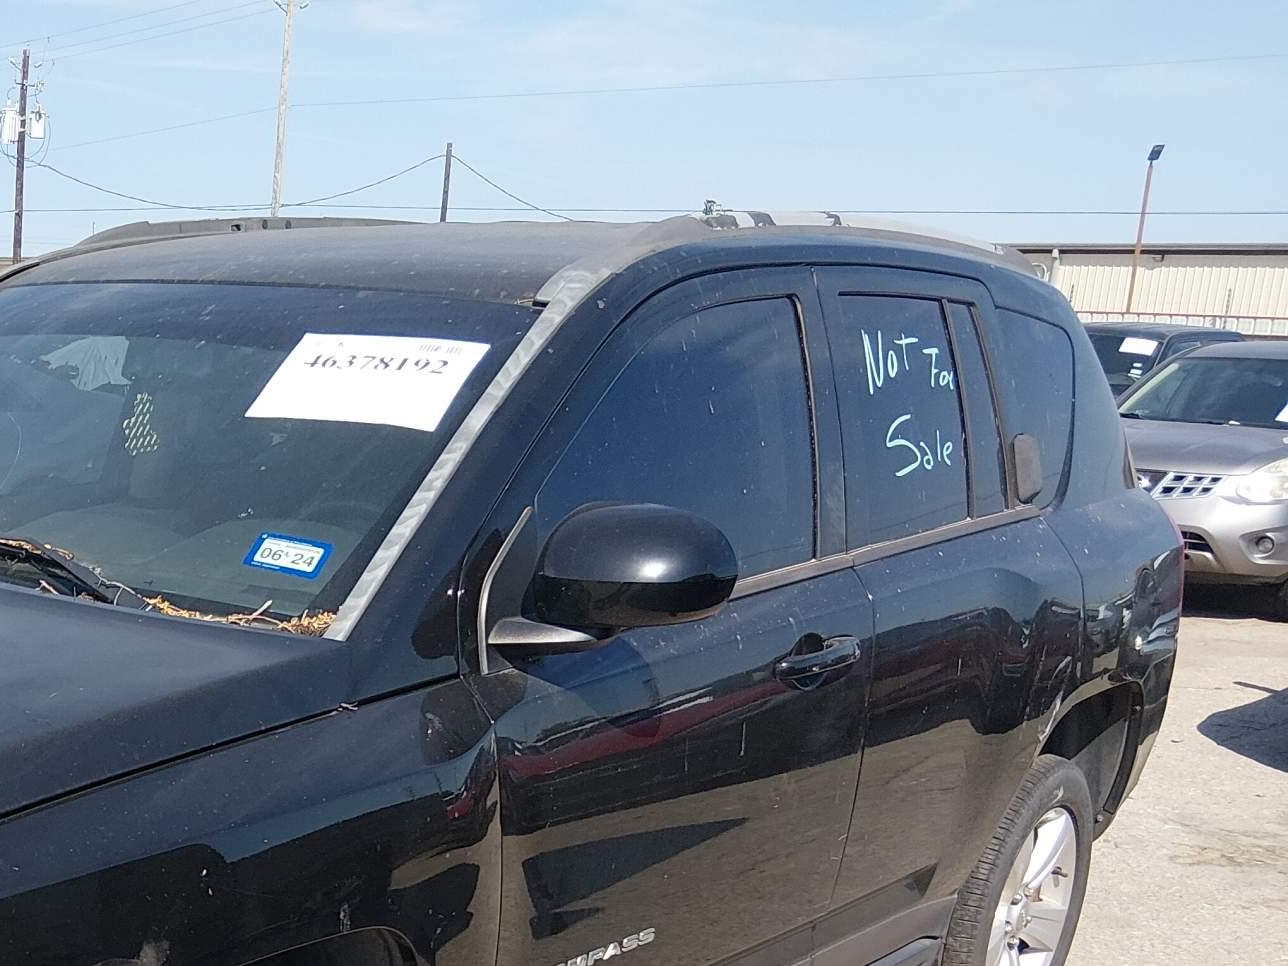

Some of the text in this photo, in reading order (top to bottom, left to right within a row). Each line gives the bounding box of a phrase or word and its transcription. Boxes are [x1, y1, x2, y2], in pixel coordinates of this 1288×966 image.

[304, 354, 448, 375] 46378192
[860, 329, 919, 395] Not
[886, 414, 953, 476] Sale
[260, 547, 284, 561] 06
[291, 553, 315, 567] 24
